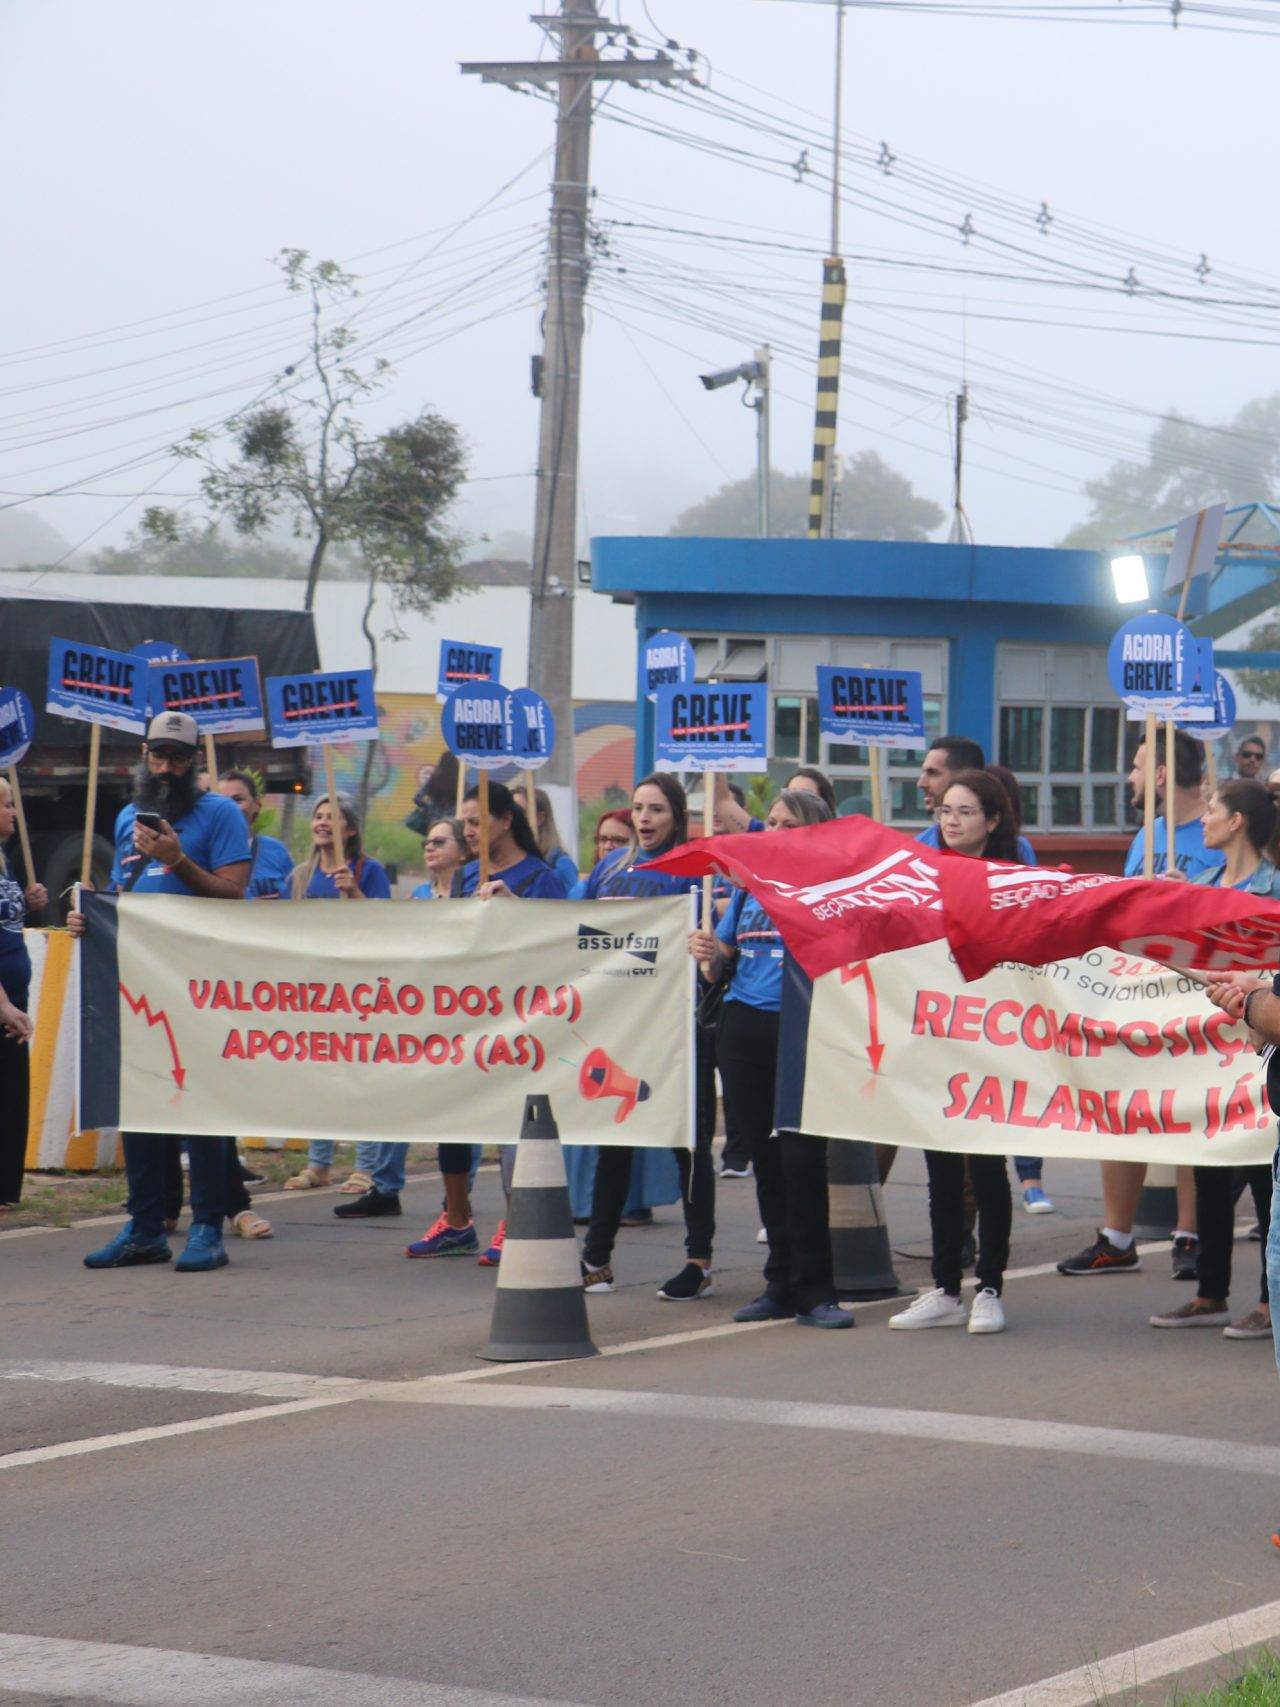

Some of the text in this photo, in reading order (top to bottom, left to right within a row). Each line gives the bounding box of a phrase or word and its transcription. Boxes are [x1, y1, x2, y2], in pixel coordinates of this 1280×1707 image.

[1123, 634, 1173, 661] AGORA
[64, 649, 135, 706] GREVE
[163, 667, 245, 711] GREVE
[282, 677, 362, 723] GREVE
[831, 675, 910, 722] GREVE
[454, 699, 502, 724] AGORA
[672, 694, 752, 741] GREVE
[577, 932, 659, 950] assufsm
[188, 977, 583, 1024] VALORIZAÇÃO DOS (AS)
[222, 1028, 546, 1073] APOSENTADOS (AS)
[912, 990, 1254, 1068] RECOMPOSIÇ
[943, 1072, 1191, 1135] SALARIAL
